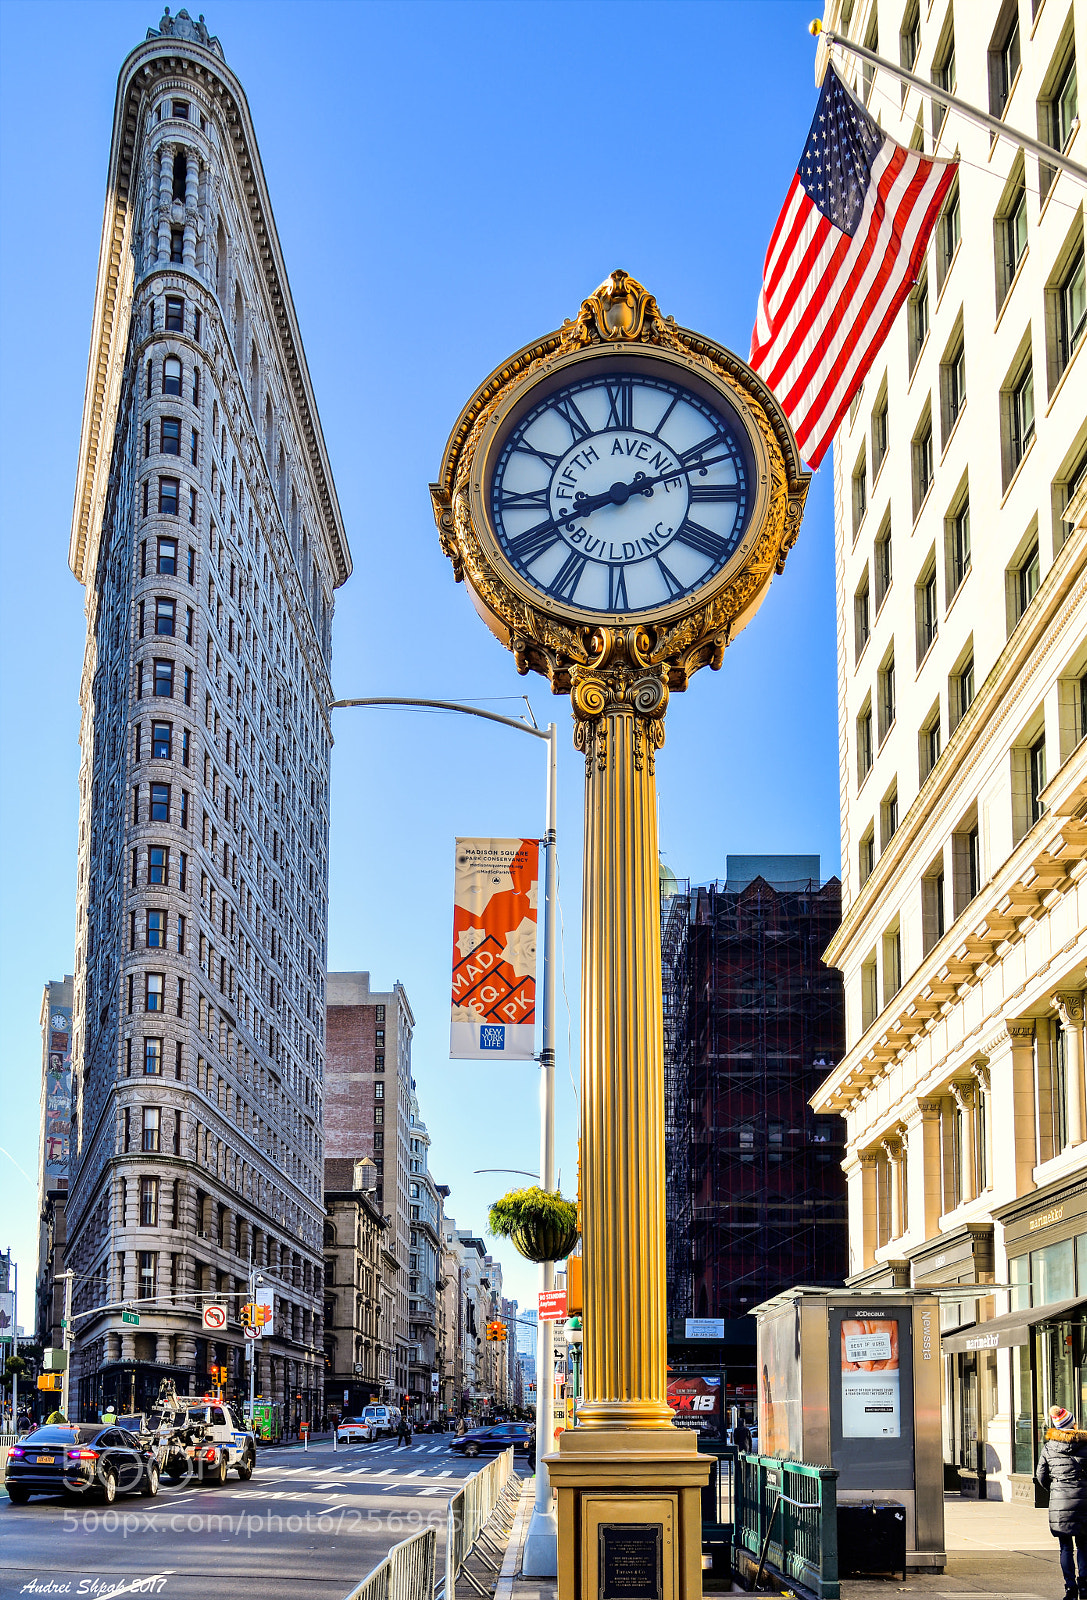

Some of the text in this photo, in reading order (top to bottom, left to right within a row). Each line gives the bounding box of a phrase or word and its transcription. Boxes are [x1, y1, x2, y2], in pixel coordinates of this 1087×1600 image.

[556, 438, 682, 500] FIFTH AVENUE
[570, 521, 674, 560] BUILDING
[503, 989, 535, 1021] PK
[481, 1033, 504, 1042] YORK
[485, 1027, 502, 1035] NEW
[484, 1040, 501, 1048] LIFE
[666, 1395, 716, 1411] 2K18
